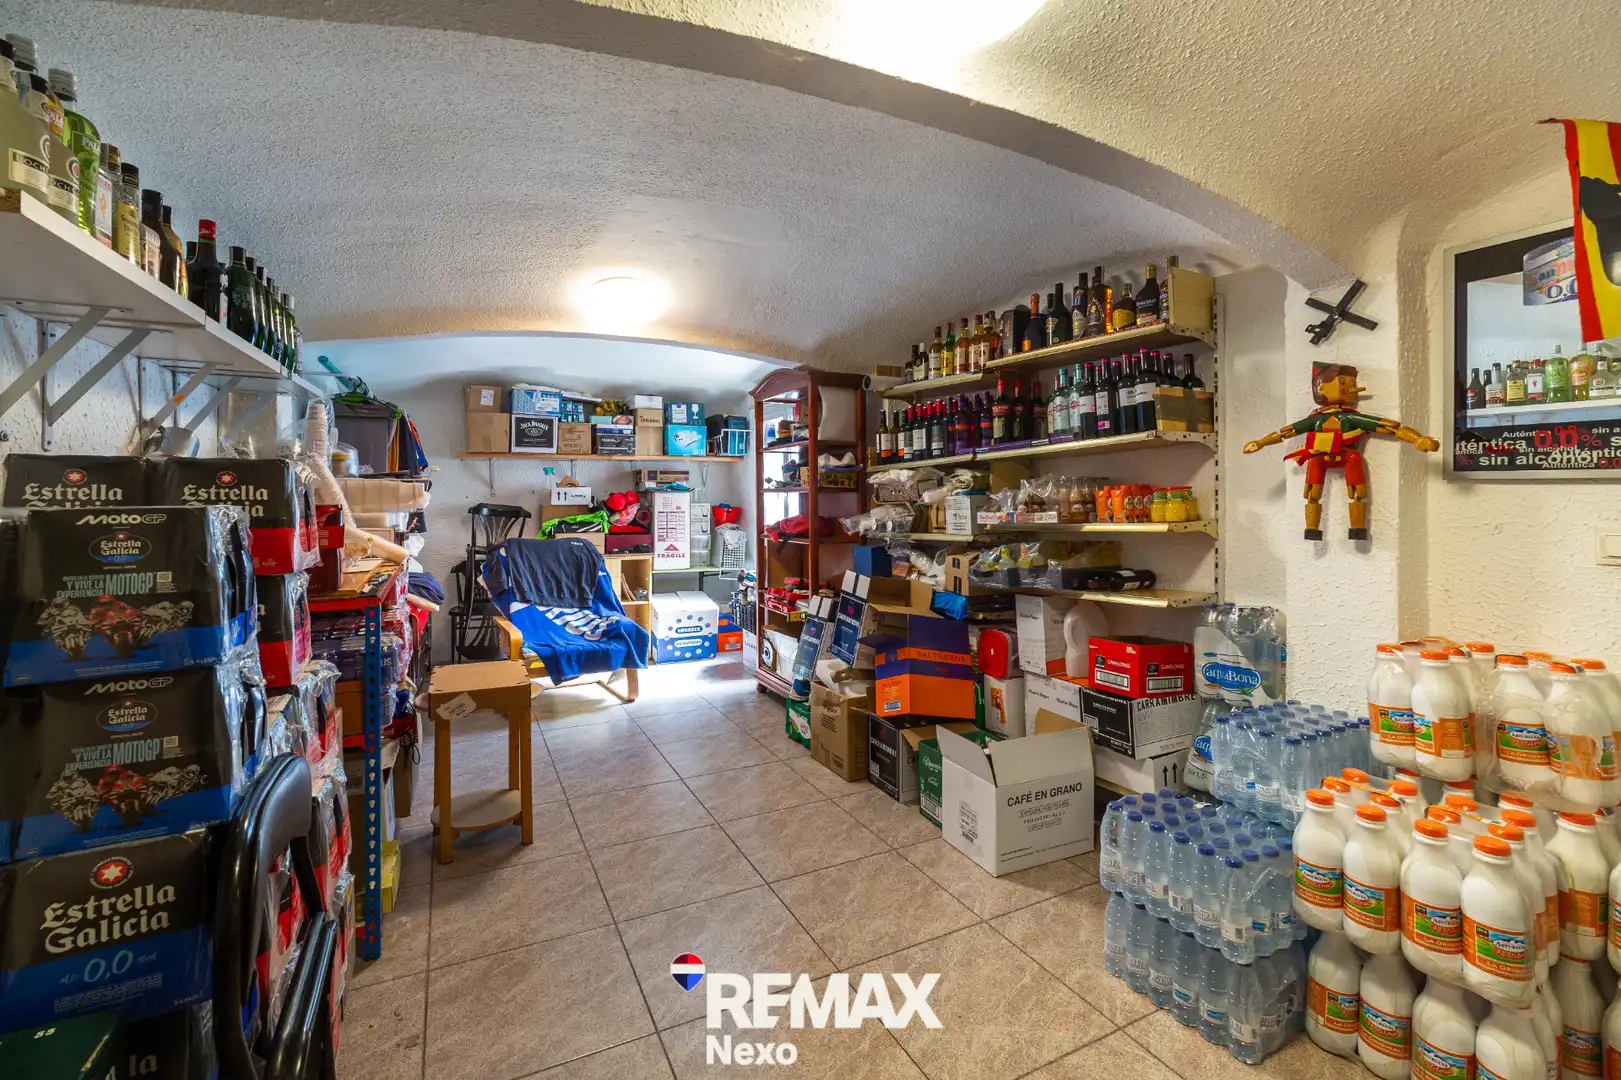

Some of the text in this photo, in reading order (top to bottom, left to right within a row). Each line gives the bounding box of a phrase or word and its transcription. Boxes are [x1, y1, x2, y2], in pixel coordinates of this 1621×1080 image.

[1479, 455, 1509, 466] sin
[1515, 452, 1599, 466] alcohol
[21, 483, 124, 501] Estrella
[180, 484, 269, 501] Estrella
[100, 540, 142, 549] Estrella
[101, 547, 139, 556] Galicia
[74, 580, 93, 590] VIVE
[95, 580, 104, 589] LA
[108, 705, 148, 717] Estrella
[108, 714, 146, 725] Galicia
[1007, 782, 1083, 807] CAFÉ EN GRANO
[40, 884, 177, 931] Estrella
[45, 909, 171, 953] Galicia
